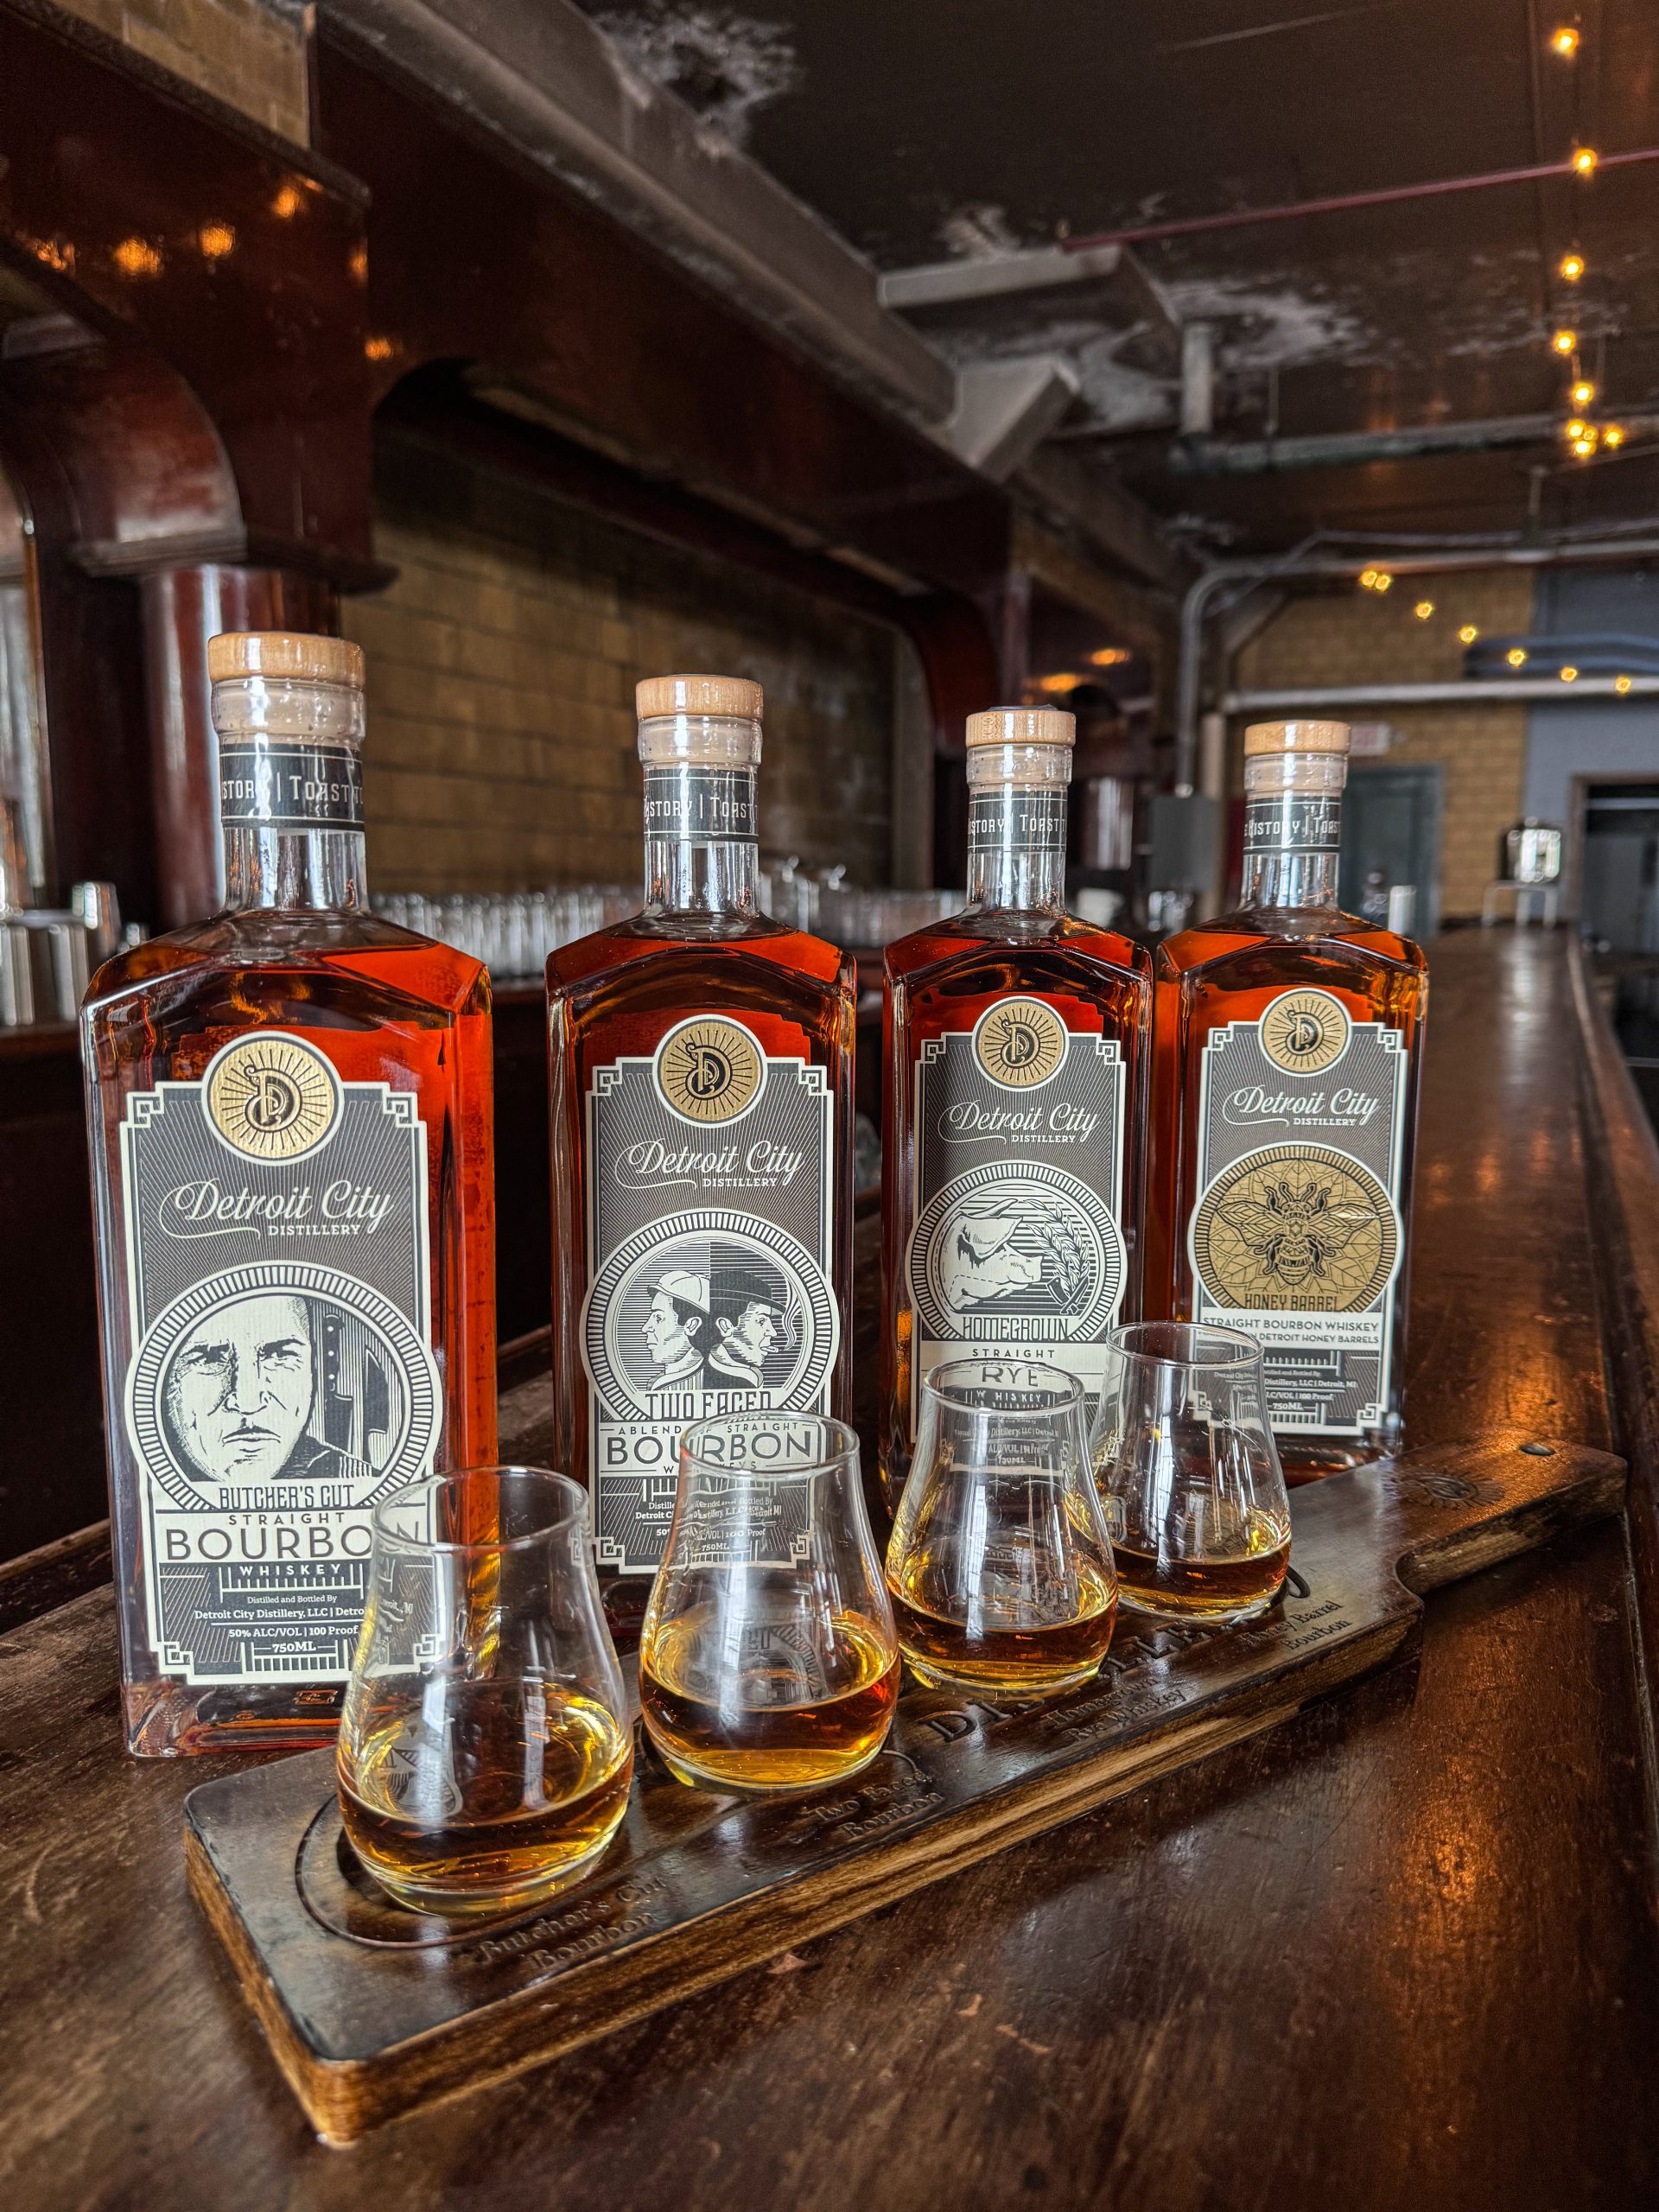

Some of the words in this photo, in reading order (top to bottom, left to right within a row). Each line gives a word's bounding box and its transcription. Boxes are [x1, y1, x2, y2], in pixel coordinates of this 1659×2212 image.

[1222, 1084, 1325, 1127] Detroit
[1330, 1087, 1382, 1126] City
[938, 1099, 1044, 1145] Detroit
[1049, 1103, 1101, 1143] City
[1293, 1117, 1356, 1126] DISTILLERY
[1011, 1135, 1076, 1143] DISTILLERY
[614, 1137, 741, 1190] Detroit
[746, 1140, 806, 1186] City
[702, 1178, 778, 1187] DISTILLERY
[160, 1178, 313, 1239] Detroit
[321, 1179, 395, 1235] City
[268, 1224, 361, 1236] DISTILLERY
[1244, 1294, 1287, 1310] HONEY
[1291, 1295, 1338, 1312] BARREL
[963, 1317, 1071, 1340] HOMEGROWN
[1203, 1318, 1262, 1329] STRAIGHT
[1263, 1319, 1321, 1330] BOURBON
[1325, 1322, 1379, 1332] WHISKEY
[1302, 1334, 1337, 1343] HONEY
[1338, 1335, 1379, 1344] BARRELS
[972, 1348, 1056, 1358] STRAIGHT
[982, 1366, 1039, 1387] RYE
[645, 1393, 694, 1420] TWO
[702, 1390, 772, 1418] FACED
[728, 1422, 798, 1434] STRAIGHT
[607, 1430, 811, 1465] BOURBON
[219, 1485, 314, 1510] BUTCHER'S
[316, 1484, 354, 1508] CUT
[229, 1512, 346, 1526] STRAIGHT
[635, 1511, 664, 1520] Detroit
[239, 1563, 342, 1577] WHISKEY
[247, 1596, 279, 1605] Distilled
[281, 1595, 296, 1604] and
[297, 1594, 326, 1604] Bottled
[327, 1594, 338, 1604] By
[194, 1609, 232, 1620] Detroit
[233, 1609, 255, 1621] City
[257, 1607, 306, 1620] Distillery,
[307, 1606, 328, 1618] LLC
[1289, 1600, 1344, 1624] Barrel
[228, 1629, 251, 1638] 50%
[253, 1627, 302, 1638] ALC/VOL
[309, 1626, 327, 1637] 100
[328, 1624, 359, 1636] Proof
[1281, 1619, 1353, 1650] Bourbon
[272, 1641, 316, 1653] 750ML
[837, 1792, 946, 1837] Bourbon
[531, 1912, 655, 1968] Bourbon
